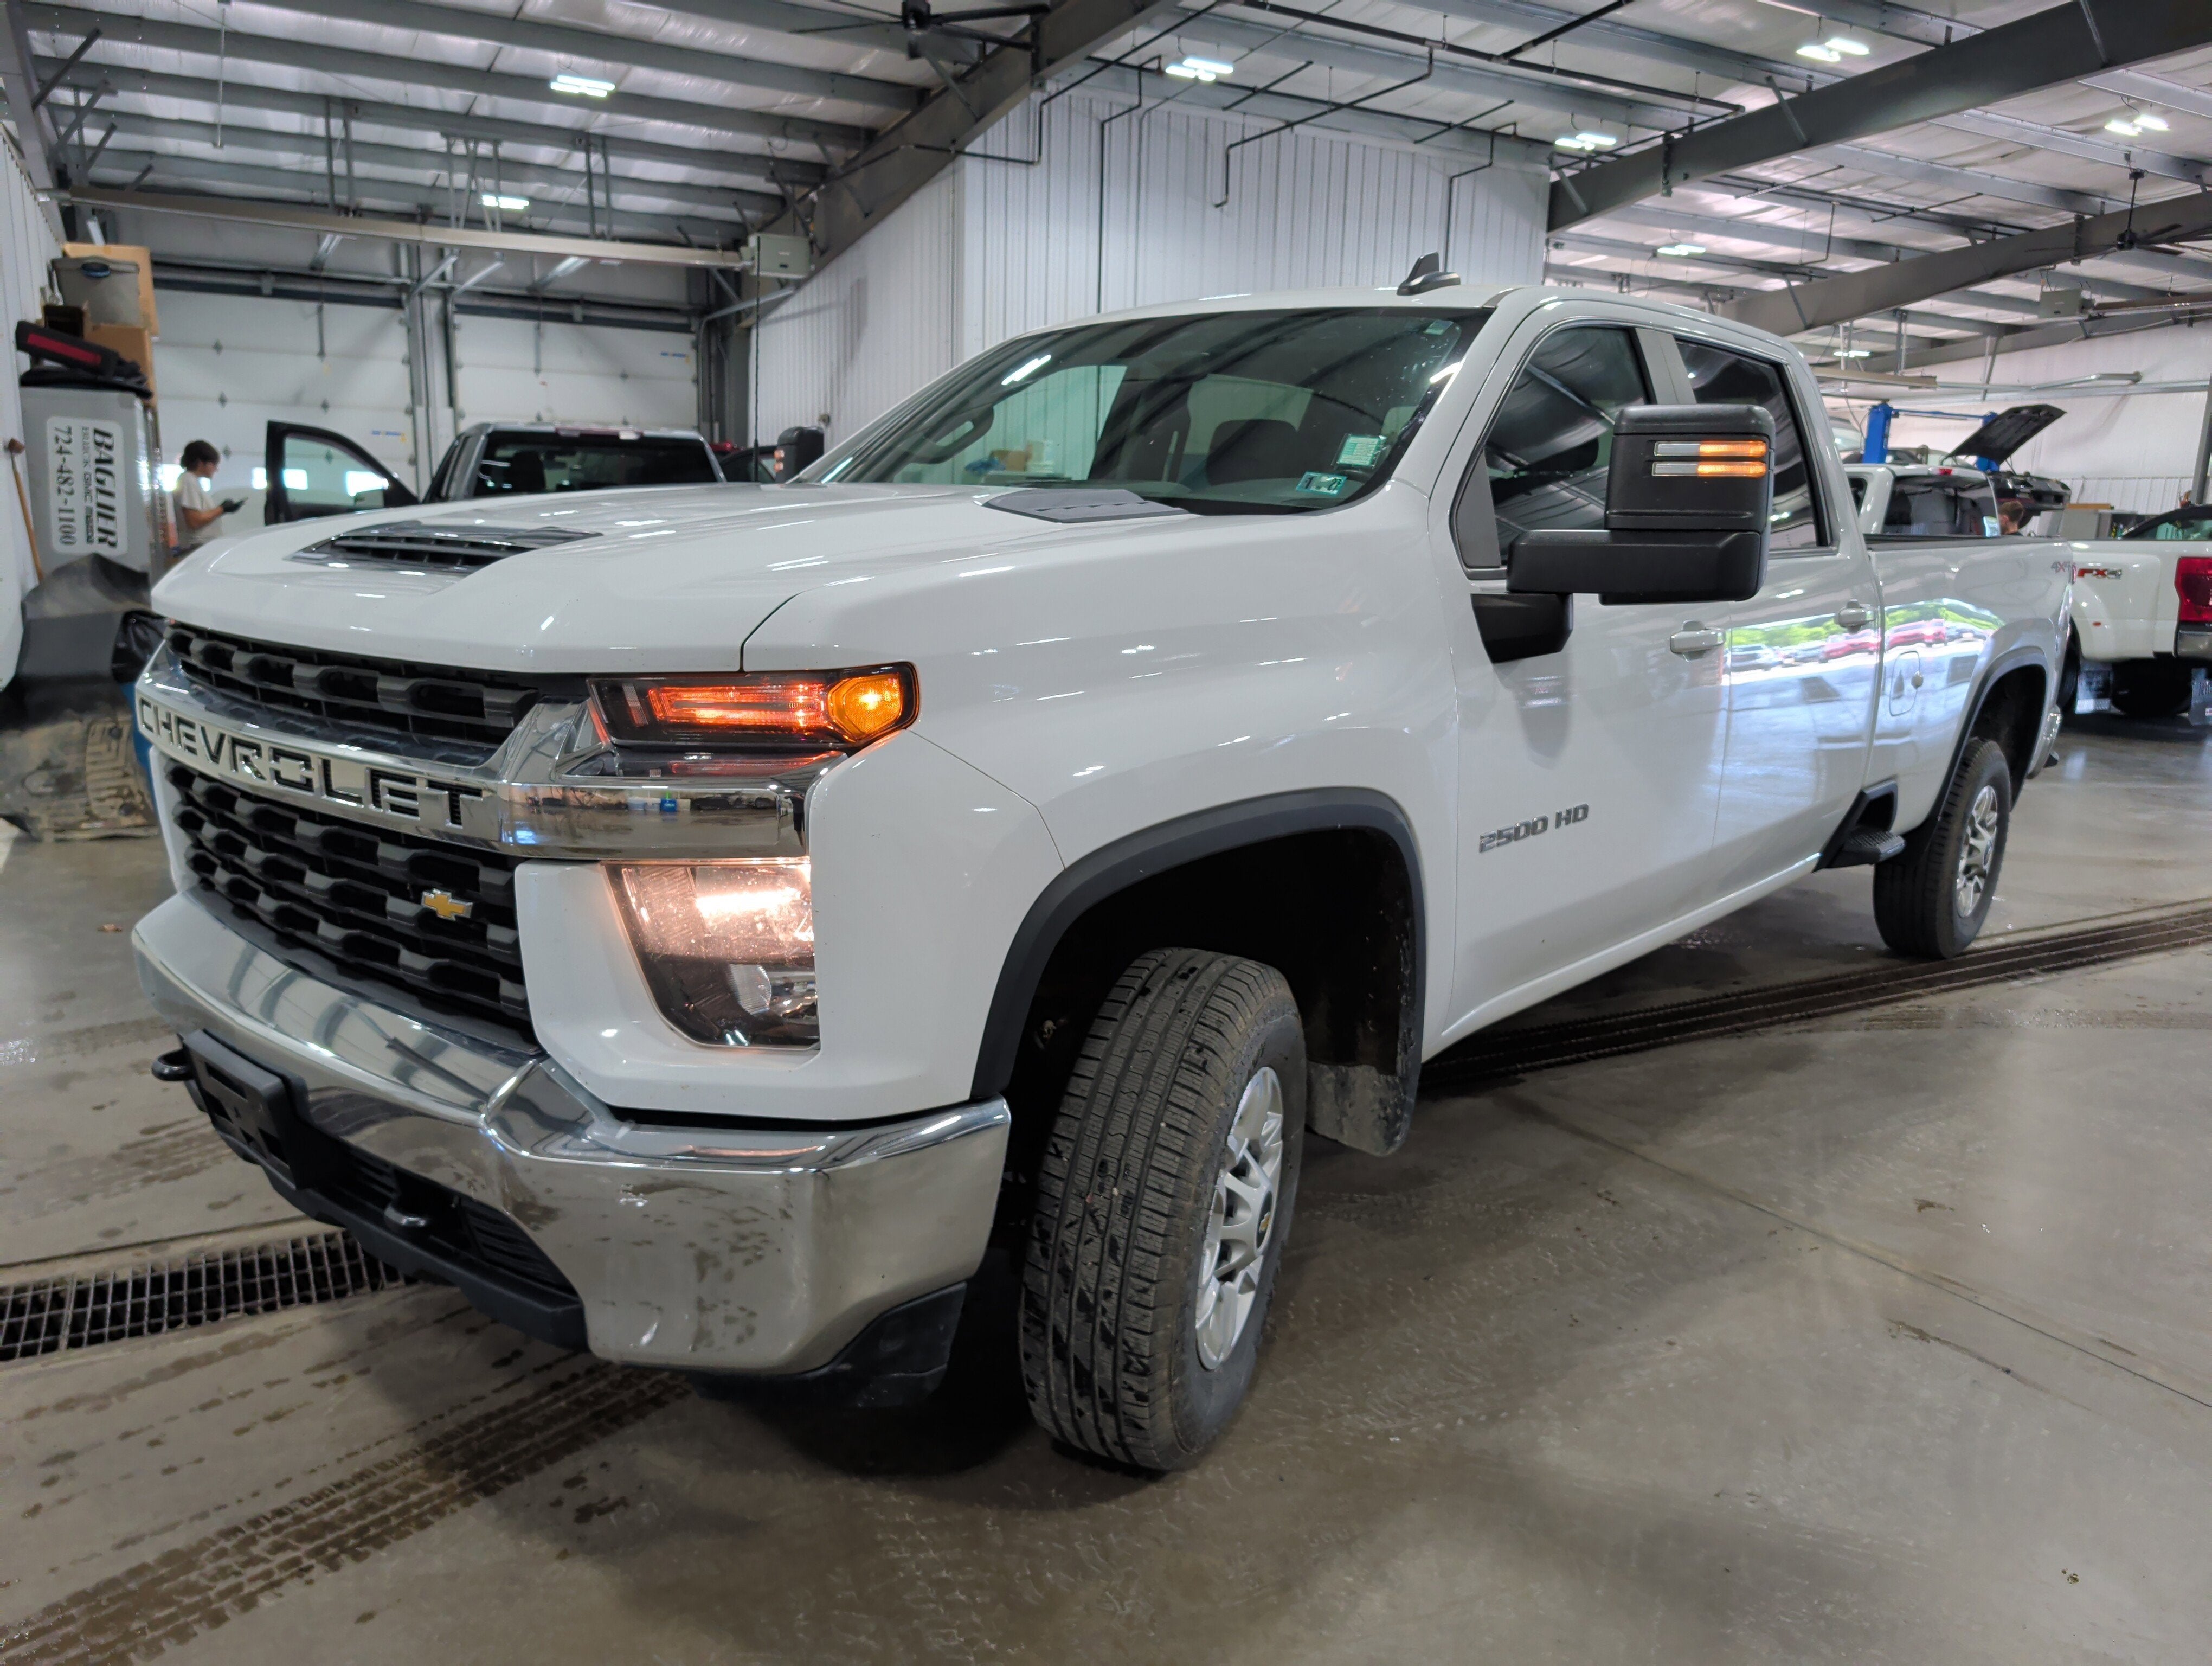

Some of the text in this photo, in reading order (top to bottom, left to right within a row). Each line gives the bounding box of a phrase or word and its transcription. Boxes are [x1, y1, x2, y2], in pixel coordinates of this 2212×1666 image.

[53, 426, 78, 546] 724-482-1100
[93, 428, 118, 548] BAGLIER
[138, 697, 484, 829] CHEVROLET
[1479, 803, 1589, 853] 2500 HD
